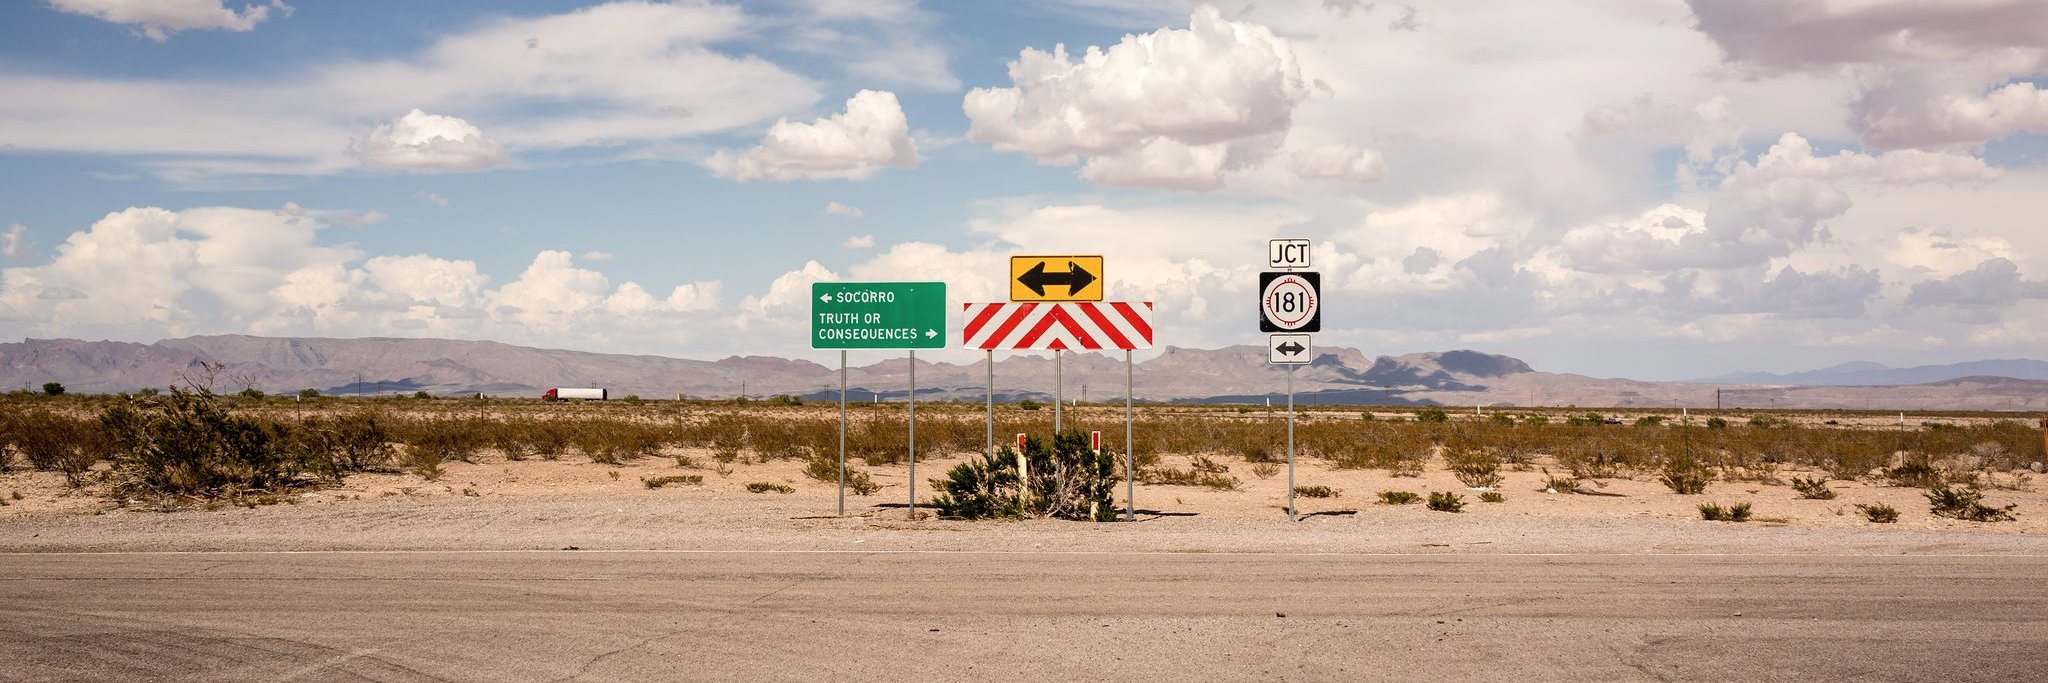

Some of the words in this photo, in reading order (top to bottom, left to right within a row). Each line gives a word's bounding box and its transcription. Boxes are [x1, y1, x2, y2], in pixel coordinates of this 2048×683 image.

[1272, 244, 1307, 263] JCT
[836, 291, 895, 303] SOCORRO
[1274, 292, 1304, 313] 181
[819, 313, 859, 324] TRUTH
[864, 313, 881, 324] OR
[818, 328, 918, 340] CONSEQUENCES
